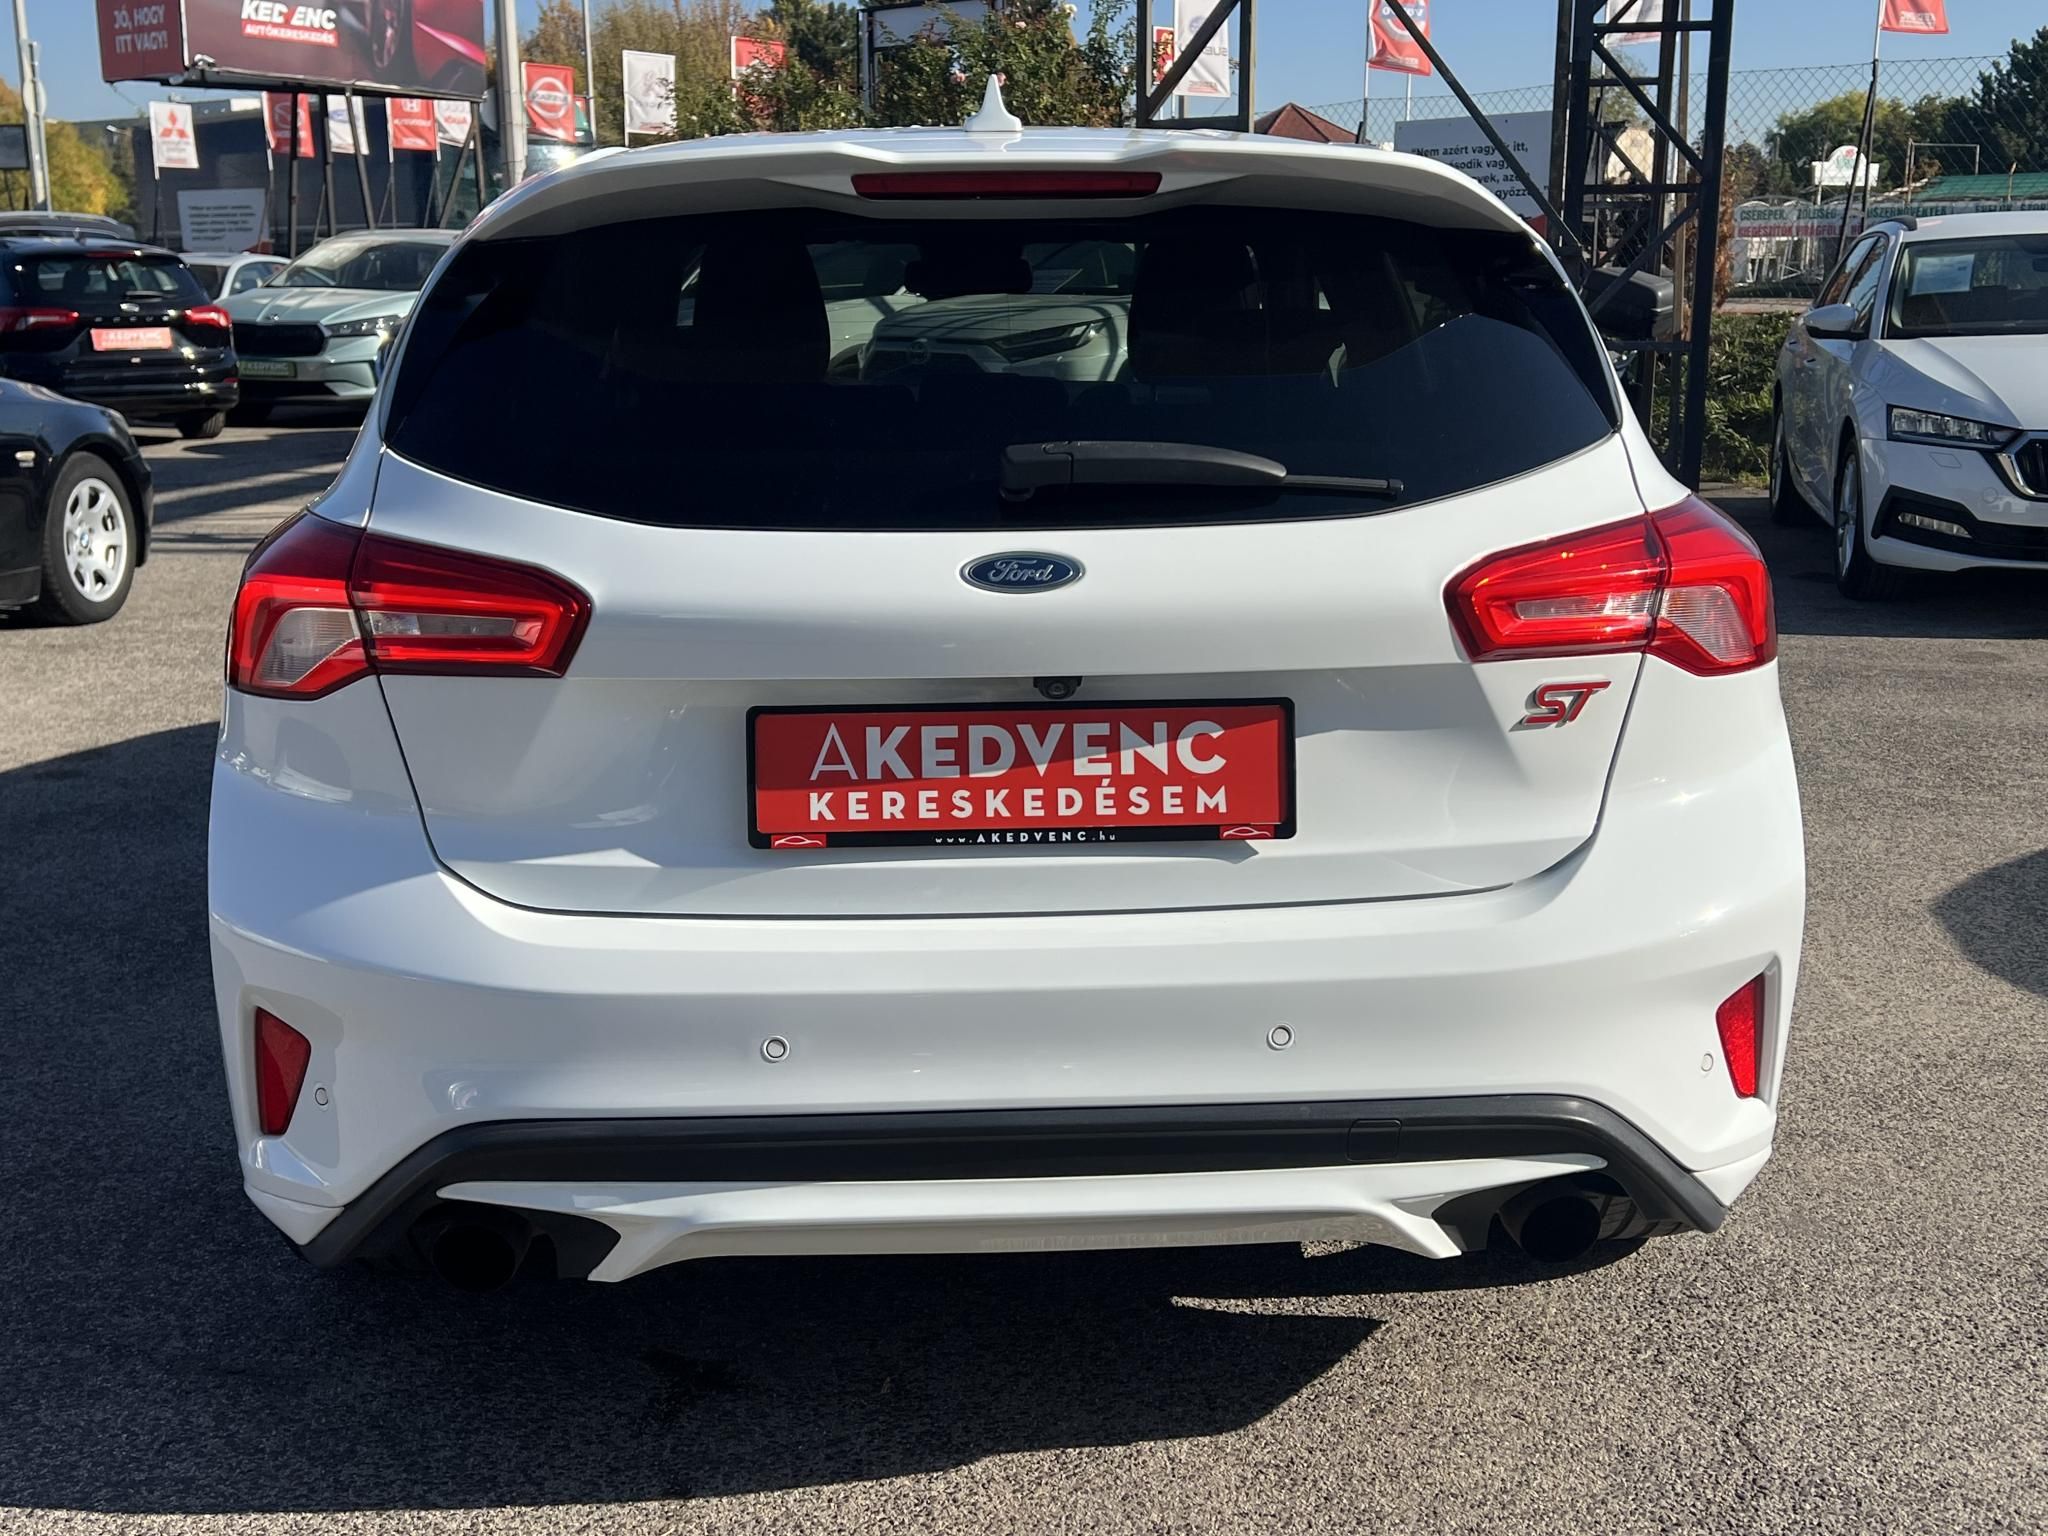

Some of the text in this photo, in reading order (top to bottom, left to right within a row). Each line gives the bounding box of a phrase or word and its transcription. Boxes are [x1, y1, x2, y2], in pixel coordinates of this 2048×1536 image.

[113, 4, 165, 30] JÓ, HOGY
[115, 30, 168, 54] ITT VAGY!
[1442, 145, 1468, 156] azért
[1513, 141, 1528, 153] itt,
[988, 559, 1054, 582] Ford
[1508, 680, 1611, 732] ST
[809, 777, 1228, 821] KERESKEDÉSEM
[935, 830, 1116, 844] www.AKEDVENC.hu
